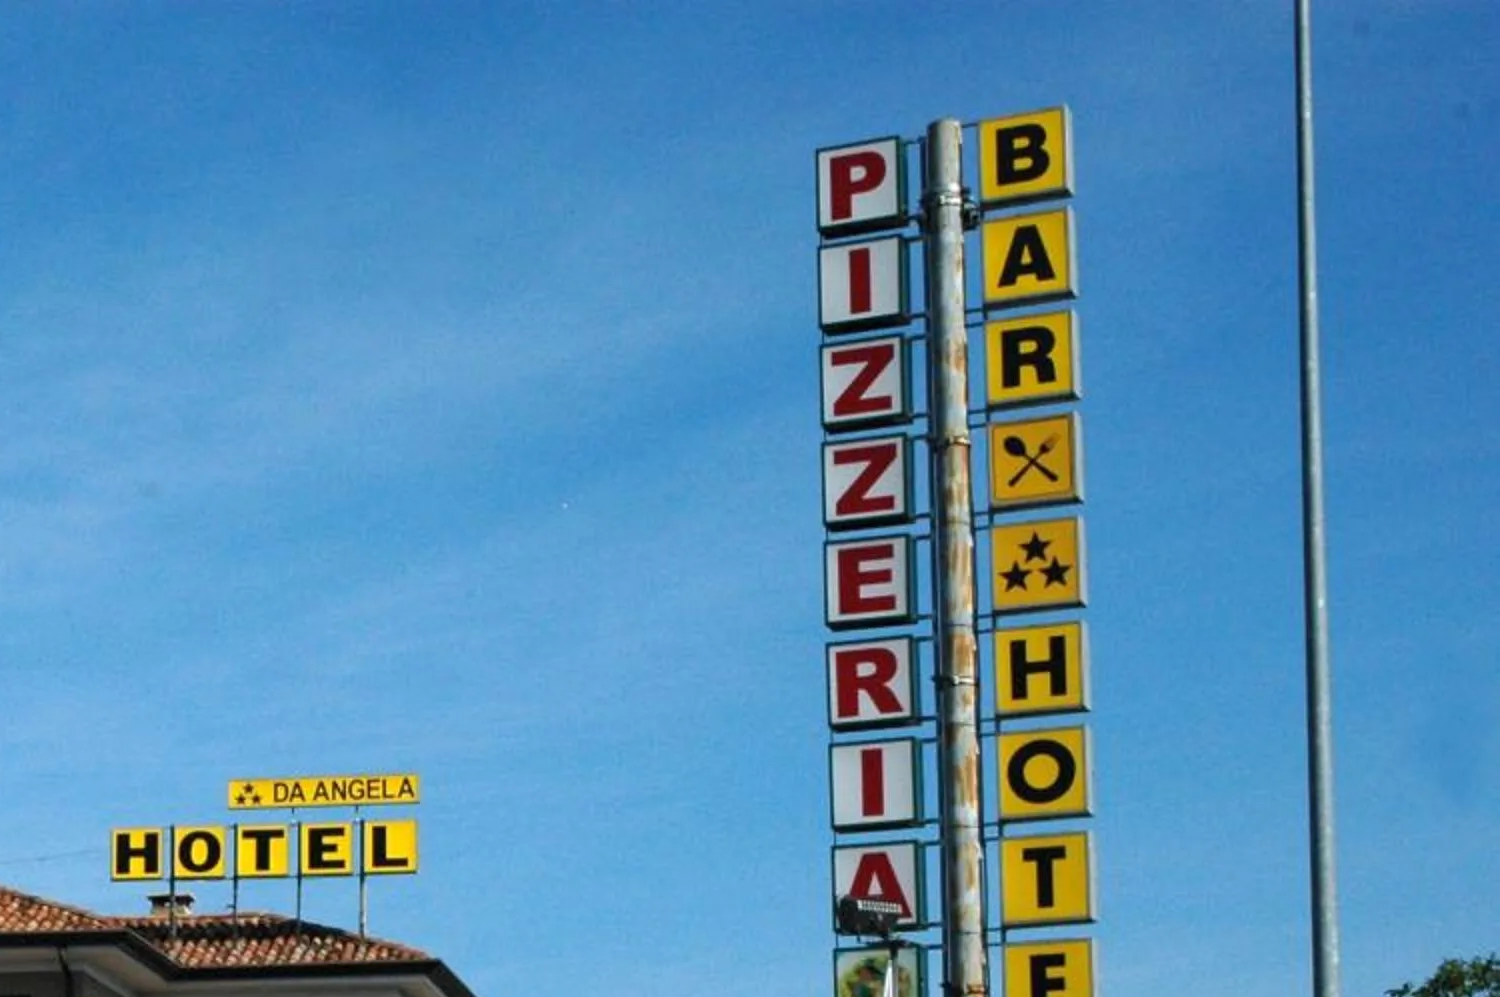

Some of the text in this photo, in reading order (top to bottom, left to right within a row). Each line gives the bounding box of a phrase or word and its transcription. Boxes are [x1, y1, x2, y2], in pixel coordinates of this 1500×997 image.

[995, 122, 1056, 389] BAR
[830, 151, 911, 919] PIZZERIA
[115, 826, 409, 875] HOTEL
[273, 777, 415, 803] DA ANGELA
